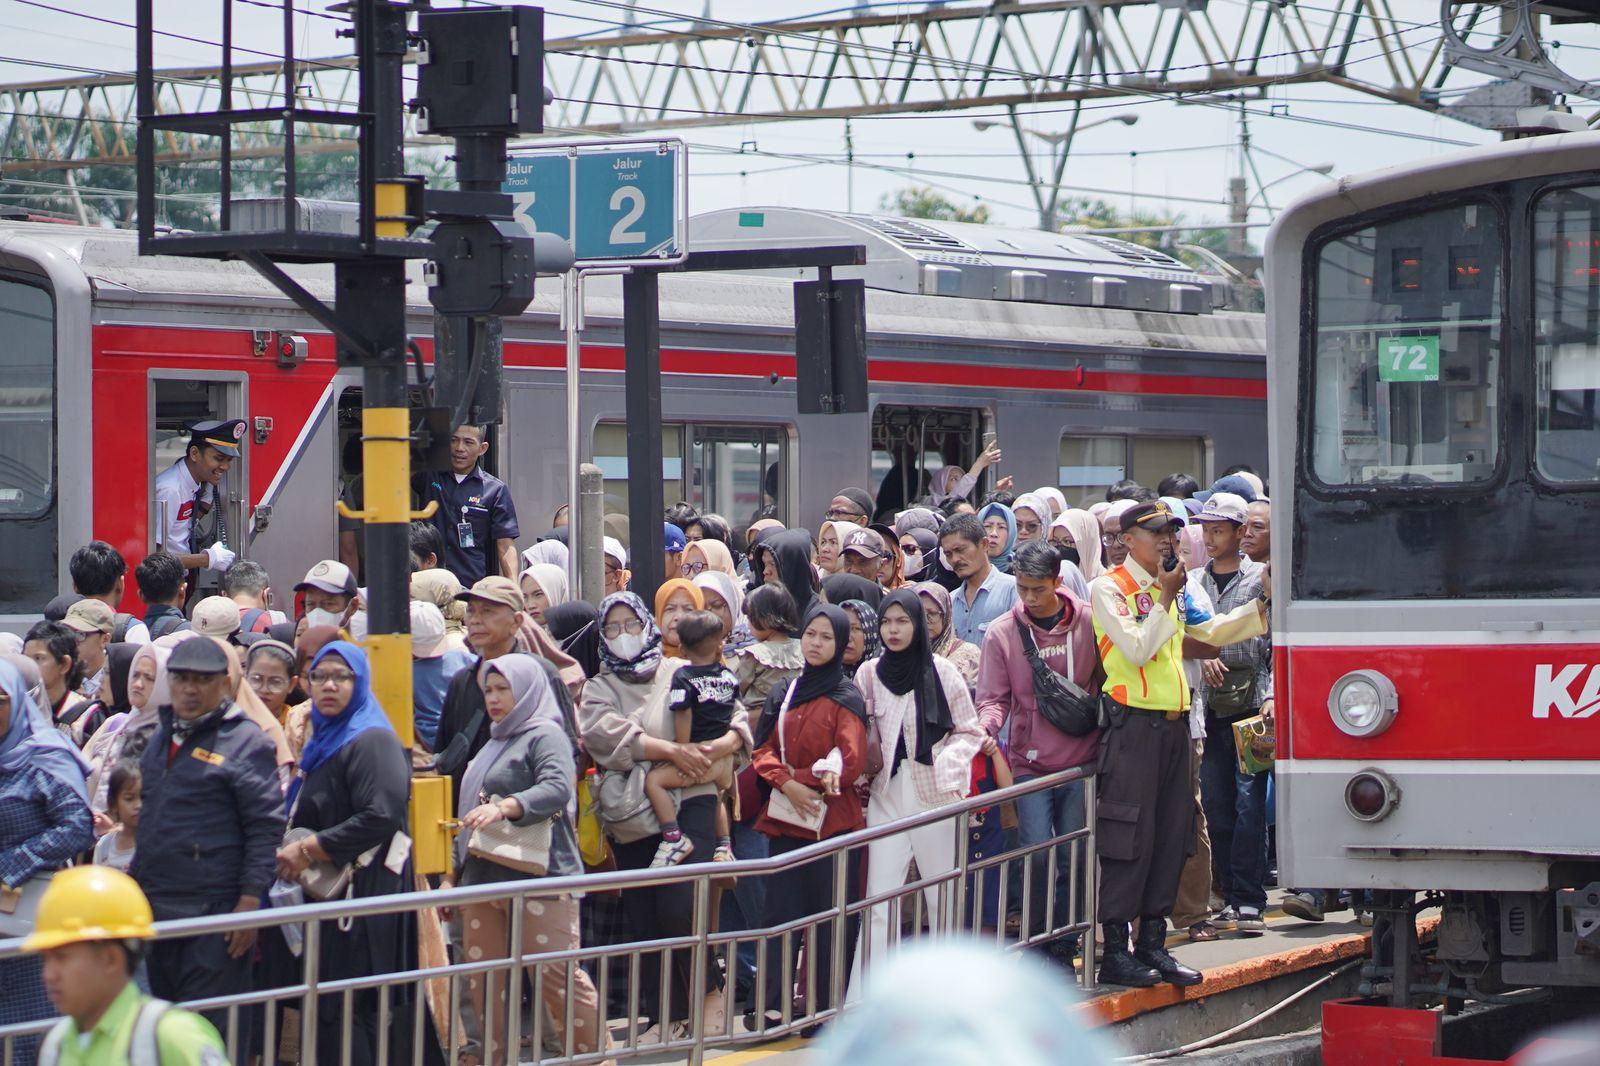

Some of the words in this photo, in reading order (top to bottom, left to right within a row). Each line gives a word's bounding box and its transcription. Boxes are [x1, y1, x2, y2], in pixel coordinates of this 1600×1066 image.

[506, 163, 533, 175] Jalur
[612, 158, 642, 170] Jalur
[508, 177, 529, 186] Track
[617, 172, 638, 181] Track
[512, 192, 537, 234] 3
[609, 185, 646, 245] 2
[1388, 344, 1428, 370] 72
